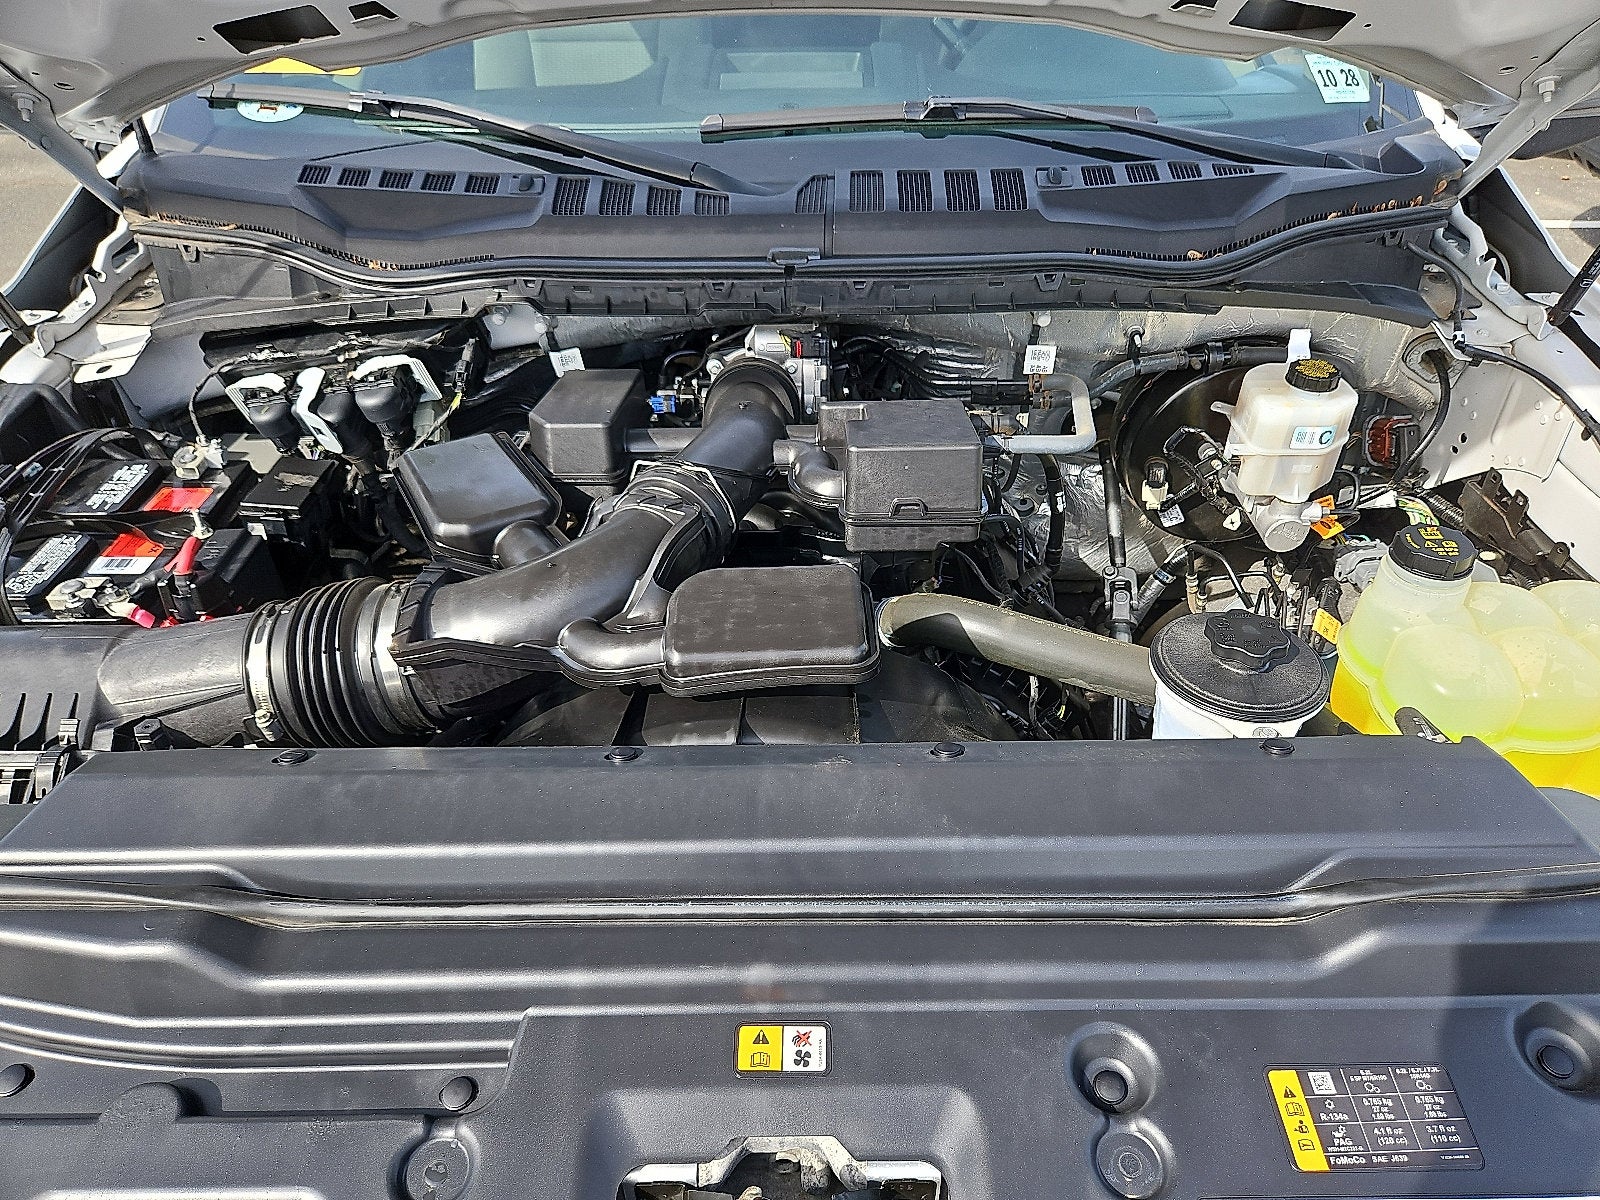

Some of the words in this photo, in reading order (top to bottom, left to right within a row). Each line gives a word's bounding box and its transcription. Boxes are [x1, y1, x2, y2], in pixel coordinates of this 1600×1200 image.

[1318, 69, 1337, 87] 10
[1340, 69, 1360, 87] 28
[1319, 430, 1333, 445] C
[1382, 1097, 1393, 1107] kg
[1434, 1094, 1445, 1105] kg
[1319, 1112, 1349, 1121] R-134a
[1373, 1127, 1385, 1135] 4.1
[1425, 1125, 1438, 1133] 3.7
[1333, 1138, 1353, 1146] PAG
[1377, 1136, 1395, 1147] (120
[1395, 1136, 1408, 1146] cc)
[1430, 1134, 1447, 1144] (110
[1448, 1134, 1461, 1144] cc)
[1329, 1155, 1366, 1165] FoMoCo
[1371, 1155, 1389, 1163] SAE
